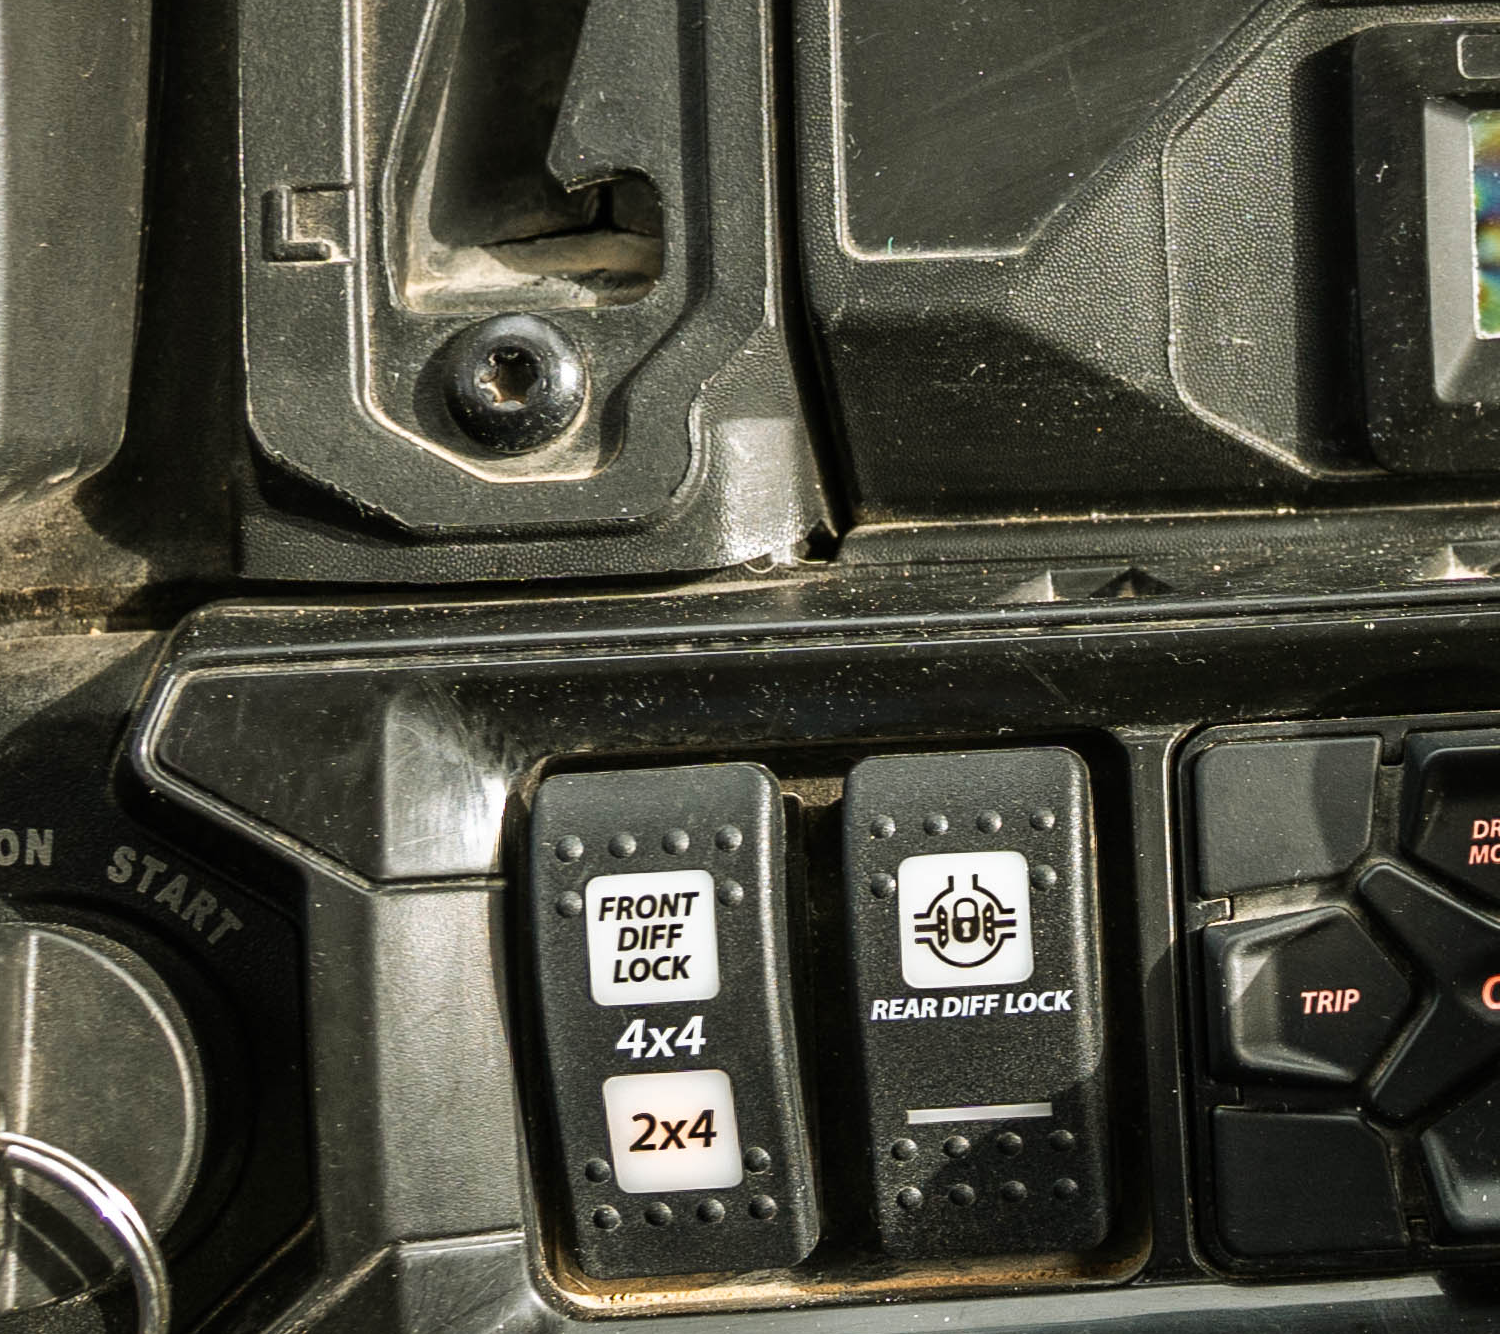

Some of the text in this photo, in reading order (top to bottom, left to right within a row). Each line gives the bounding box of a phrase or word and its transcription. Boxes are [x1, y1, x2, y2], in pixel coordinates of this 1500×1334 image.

[263, 188, 330, 262] L
[105, 845, 245, 946] START
[598, 891, 700, 922] FRONT
[616, 923, 684, 952] DIFF
[612, 954, 692, 984] LOCK
[870, 989, 1074, 1021] REAR DIFF LOCK
[1300, 988, 1361, 1014] TRIP
[615, 1015, 707, 1060] 4x4
[628, 1108, 718, 1153] 2x4
